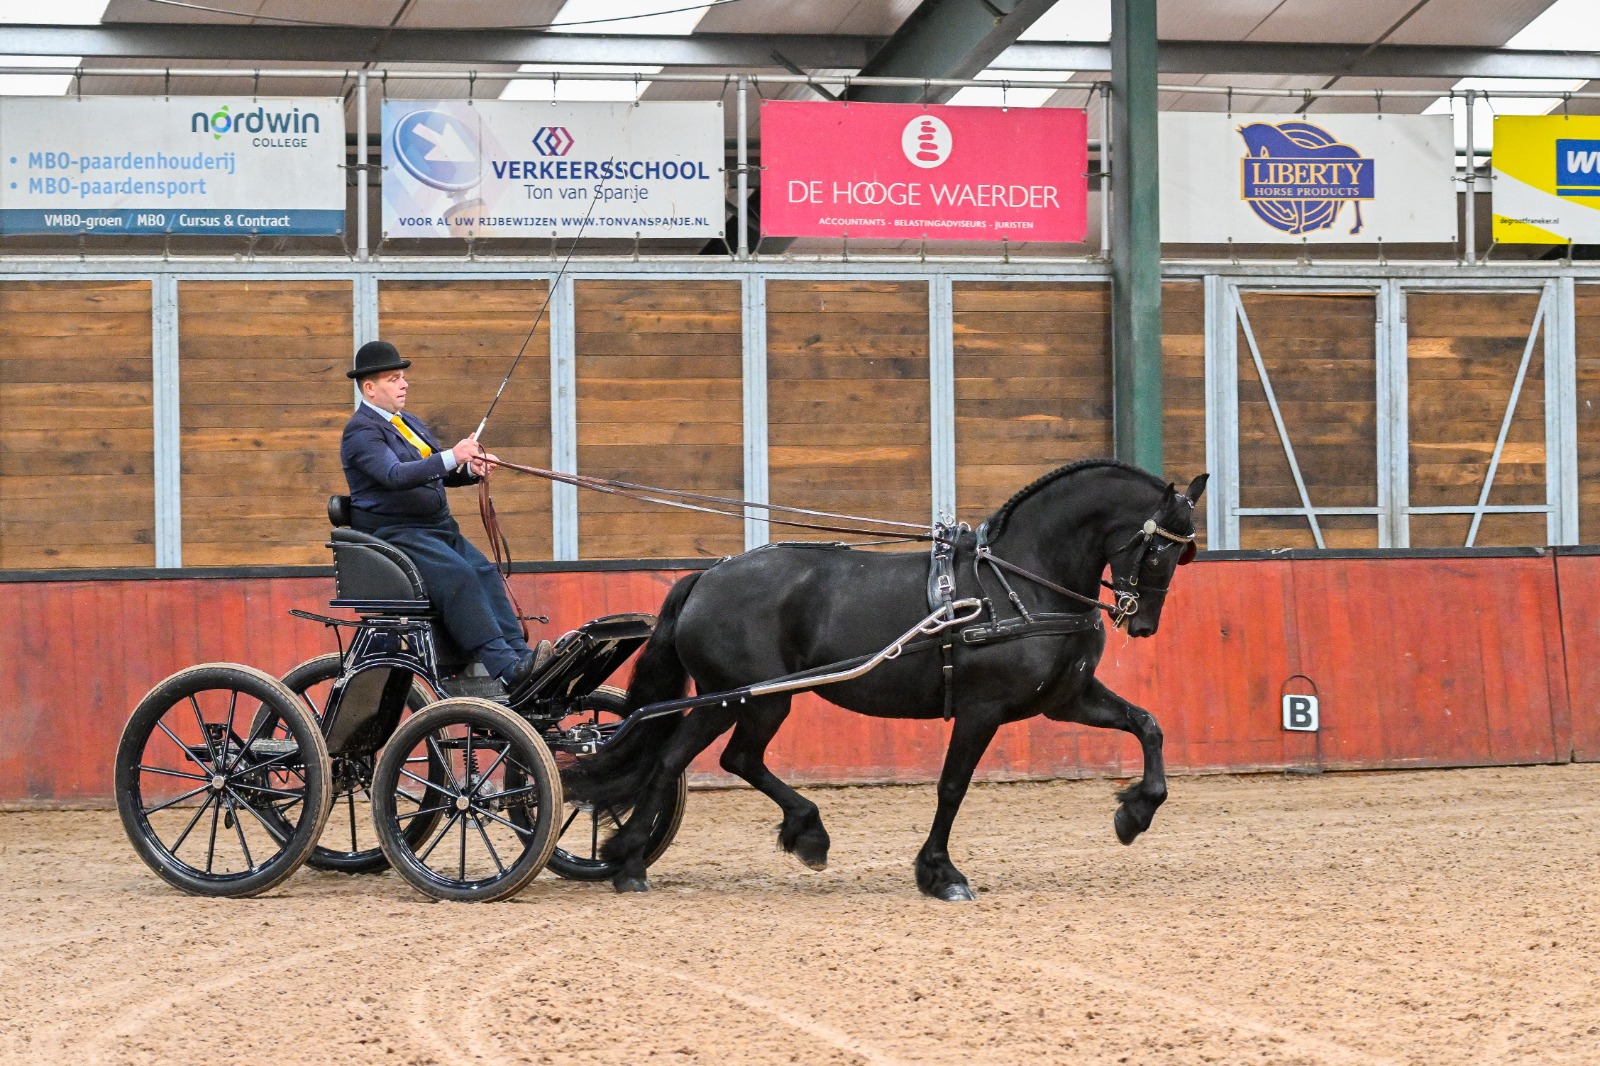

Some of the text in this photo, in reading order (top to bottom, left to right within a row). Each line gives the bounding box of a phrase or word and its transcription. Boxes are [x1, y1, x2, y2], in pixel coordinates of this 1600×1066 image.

[191, 105, 319, 140] nordwin
[252, 137, 308, 148] COLLEGE
[28, 151, 236, 175] MBO-paardenhouderij
[492, 160, 710, 180] VERKEERSSCHOOL
[1251, 162, 1364, 186] LIBERTY
[28, 176, 207, 199] MBO-paardensport
[523, 184, 649, 204] Ton van Spanje
[788, 180, 1061, 208] DE HOOGE WAERDER
[1254, 187, 1360, 196] HORSE PRODUCTS
[44, 214, 122, 229] VMBO-groen
[137, 214, 165, 227] MBO
[179, 214, 220, 227] Cursus
[223, 214, 234, 227] &
[237, 214, 290, 227] Contract
[399, 217, 710, 227] VOOR AL UW RIJBEWIJZEN WWW.TONVANSPANJE.NL
[818, 217, 886, 227] ACCOUNTANTS
[894, 219, 987, 229] BELASTINGADVISEURS
[994, 221, 1034, 230] JURISTEN
[1500, 217, 1560, 226] degrootfraneker.nl
[1289, 697, 1312, 728] B
